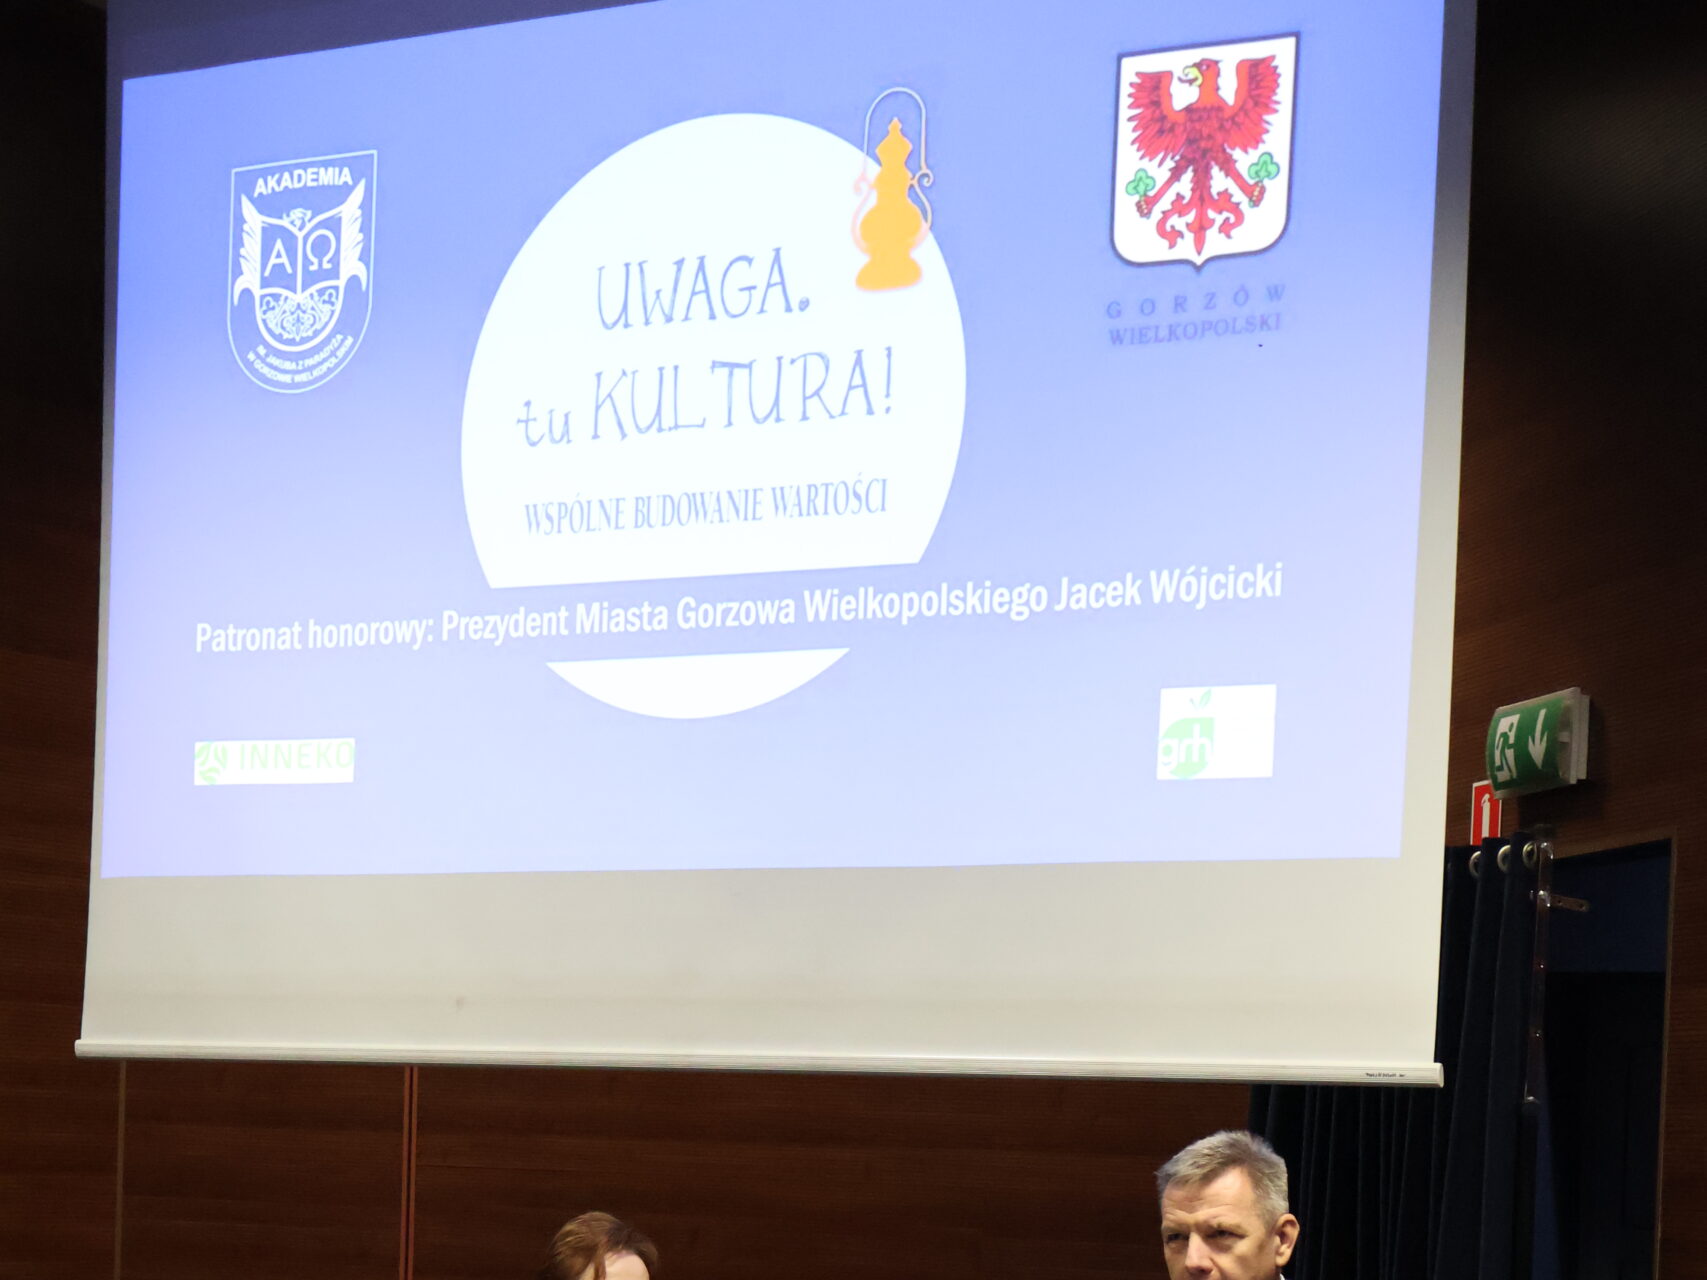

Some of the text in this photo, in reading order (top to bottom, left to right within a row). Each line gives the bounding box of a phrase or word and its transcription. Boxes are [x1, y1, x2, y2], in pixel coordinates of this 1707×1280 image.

[254, 167, 353, 197] AKADEMIA
[596, 246, 811, 331] UWAGA.
[1108, 312, 1282, 346] WIELKOPOLSKI
[516, 345, 893, 448] tu KULTURA!
[525, 472, 888, 536] WSPÓLNE BUDOWANIE WARTOŚCI
[195, 561, 1283, 653] Patronat honorowy: Prezydent Miasta Gorzowa Wielkopolskiego Jacek Wójcicki
[239, 741, 354, 770] INNEKO
